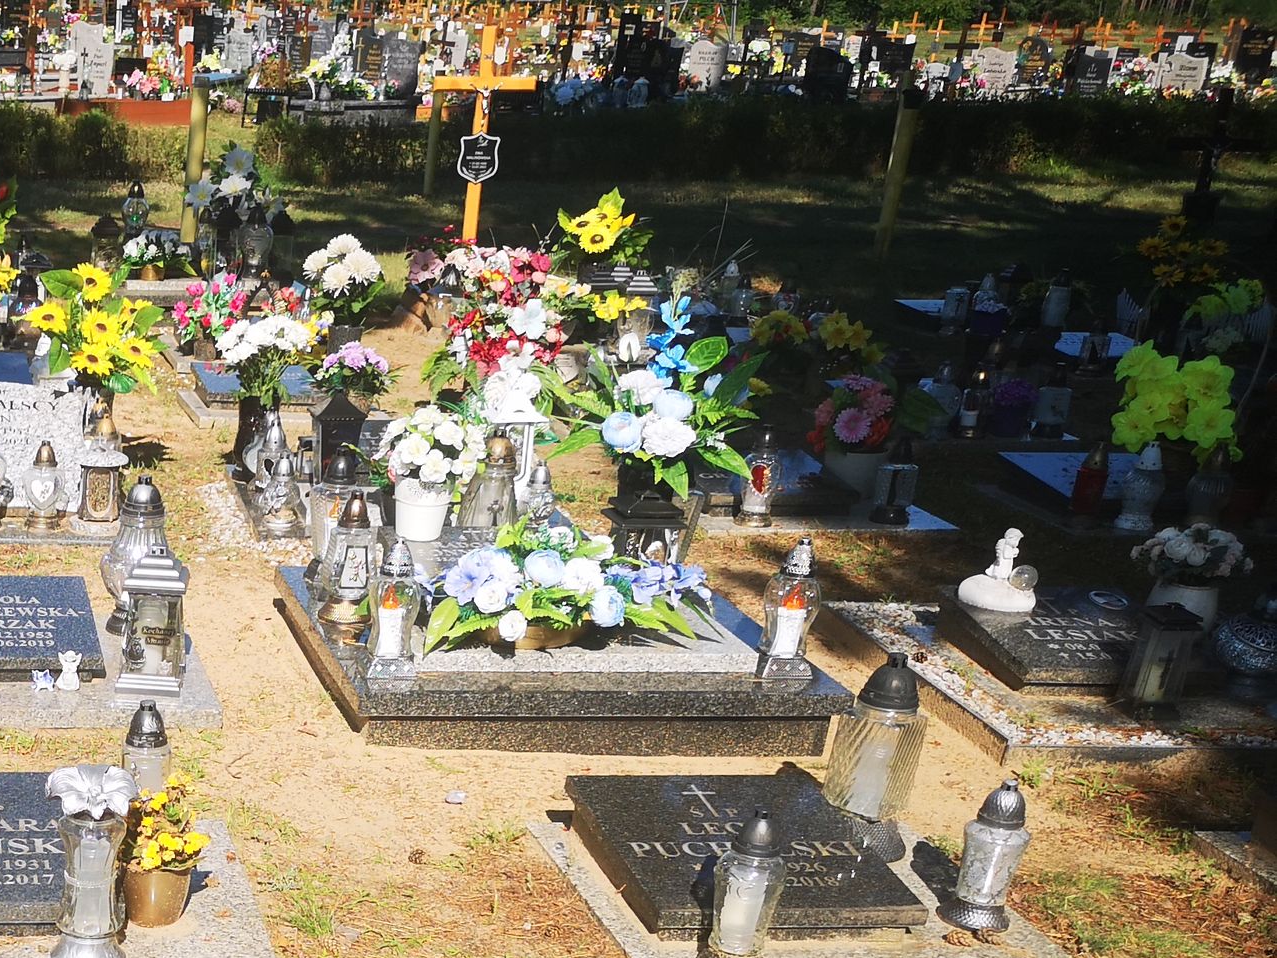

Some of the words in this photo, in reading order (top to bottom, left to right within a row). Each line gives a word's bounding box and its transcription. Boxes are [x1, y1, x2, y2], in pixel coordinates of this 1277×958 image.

[1023, 616, 1118, 627] IRENA
[1024, 628, 1142, 641] LESIAK
[0, 639, 55, 648] 06.2019
[678, 822, 745, 835] LEC
[627, 841, 872, 857] PUCHSKI
